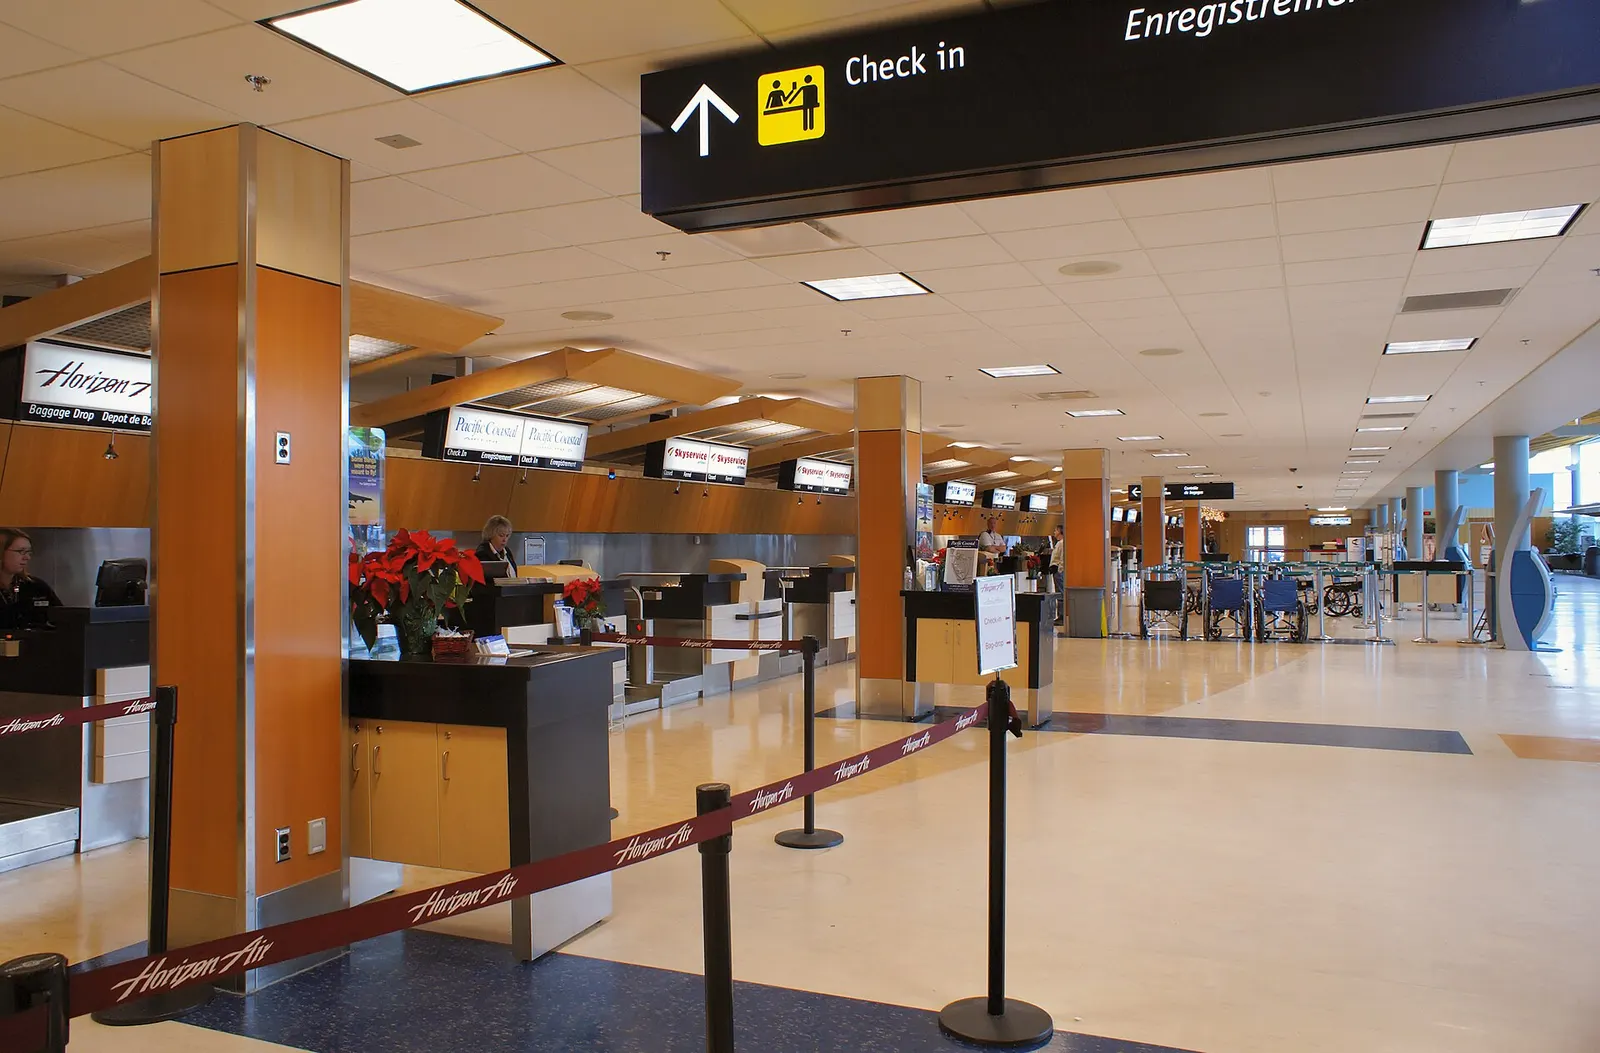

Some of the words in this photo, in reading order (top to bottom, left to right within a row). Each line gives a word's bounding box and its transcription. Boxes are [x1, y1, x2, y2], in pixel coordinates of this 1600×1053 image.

[846, 46, 926, 85] Check
[937, 41, 965, 71] in
[35, 361, 130, 394] Horizon
[29, 404, 70, 419] Baggage
[73, 409, 94, 421] Drop
[102, 412, 128, 424] Depot
[129, 415, 140, 425] de
[455, 416, 486, 435] Pacific
[485, 421, 519, 438] Coastal
[529, 427, 555, 442] Pacific
[555, 431, 583, 446] Coastal
[447, 449, 460, 457] Check
[674, 448, 707, 460] Skyservice
[717, 455, 747, 466] Skyservice
[802, 466, 824, 476] Skyservice
[830, 470, 850, 480] Skyservice
[616, 636, 636, 644] Horizon
[680, 639, 702, 648] Horizon
[700, 640, 714, 648] Air
[748, 640, 769, 649] Horizon
[767, 641, 782, 649] Air
[123, 700, 157, 715] Horizon
[0, 718, 42, 735] Horizon
[41, 713, 65, 729] Air
[834, 761, 858, 782] Horizon
[857, 754, 871, 773] Air
[749, 789, 778, 813] Horizon
[777, 781, 794, 803] Air
[613, 836, 667, 866] Horizon
[666, 822, 694, 849] Air
[407, 888, 481, 923] Horizon
[480, 872, 519, 904] Air
[110, 957, 221, 1003] Horizon
[218, 935, 274, 974] Air
